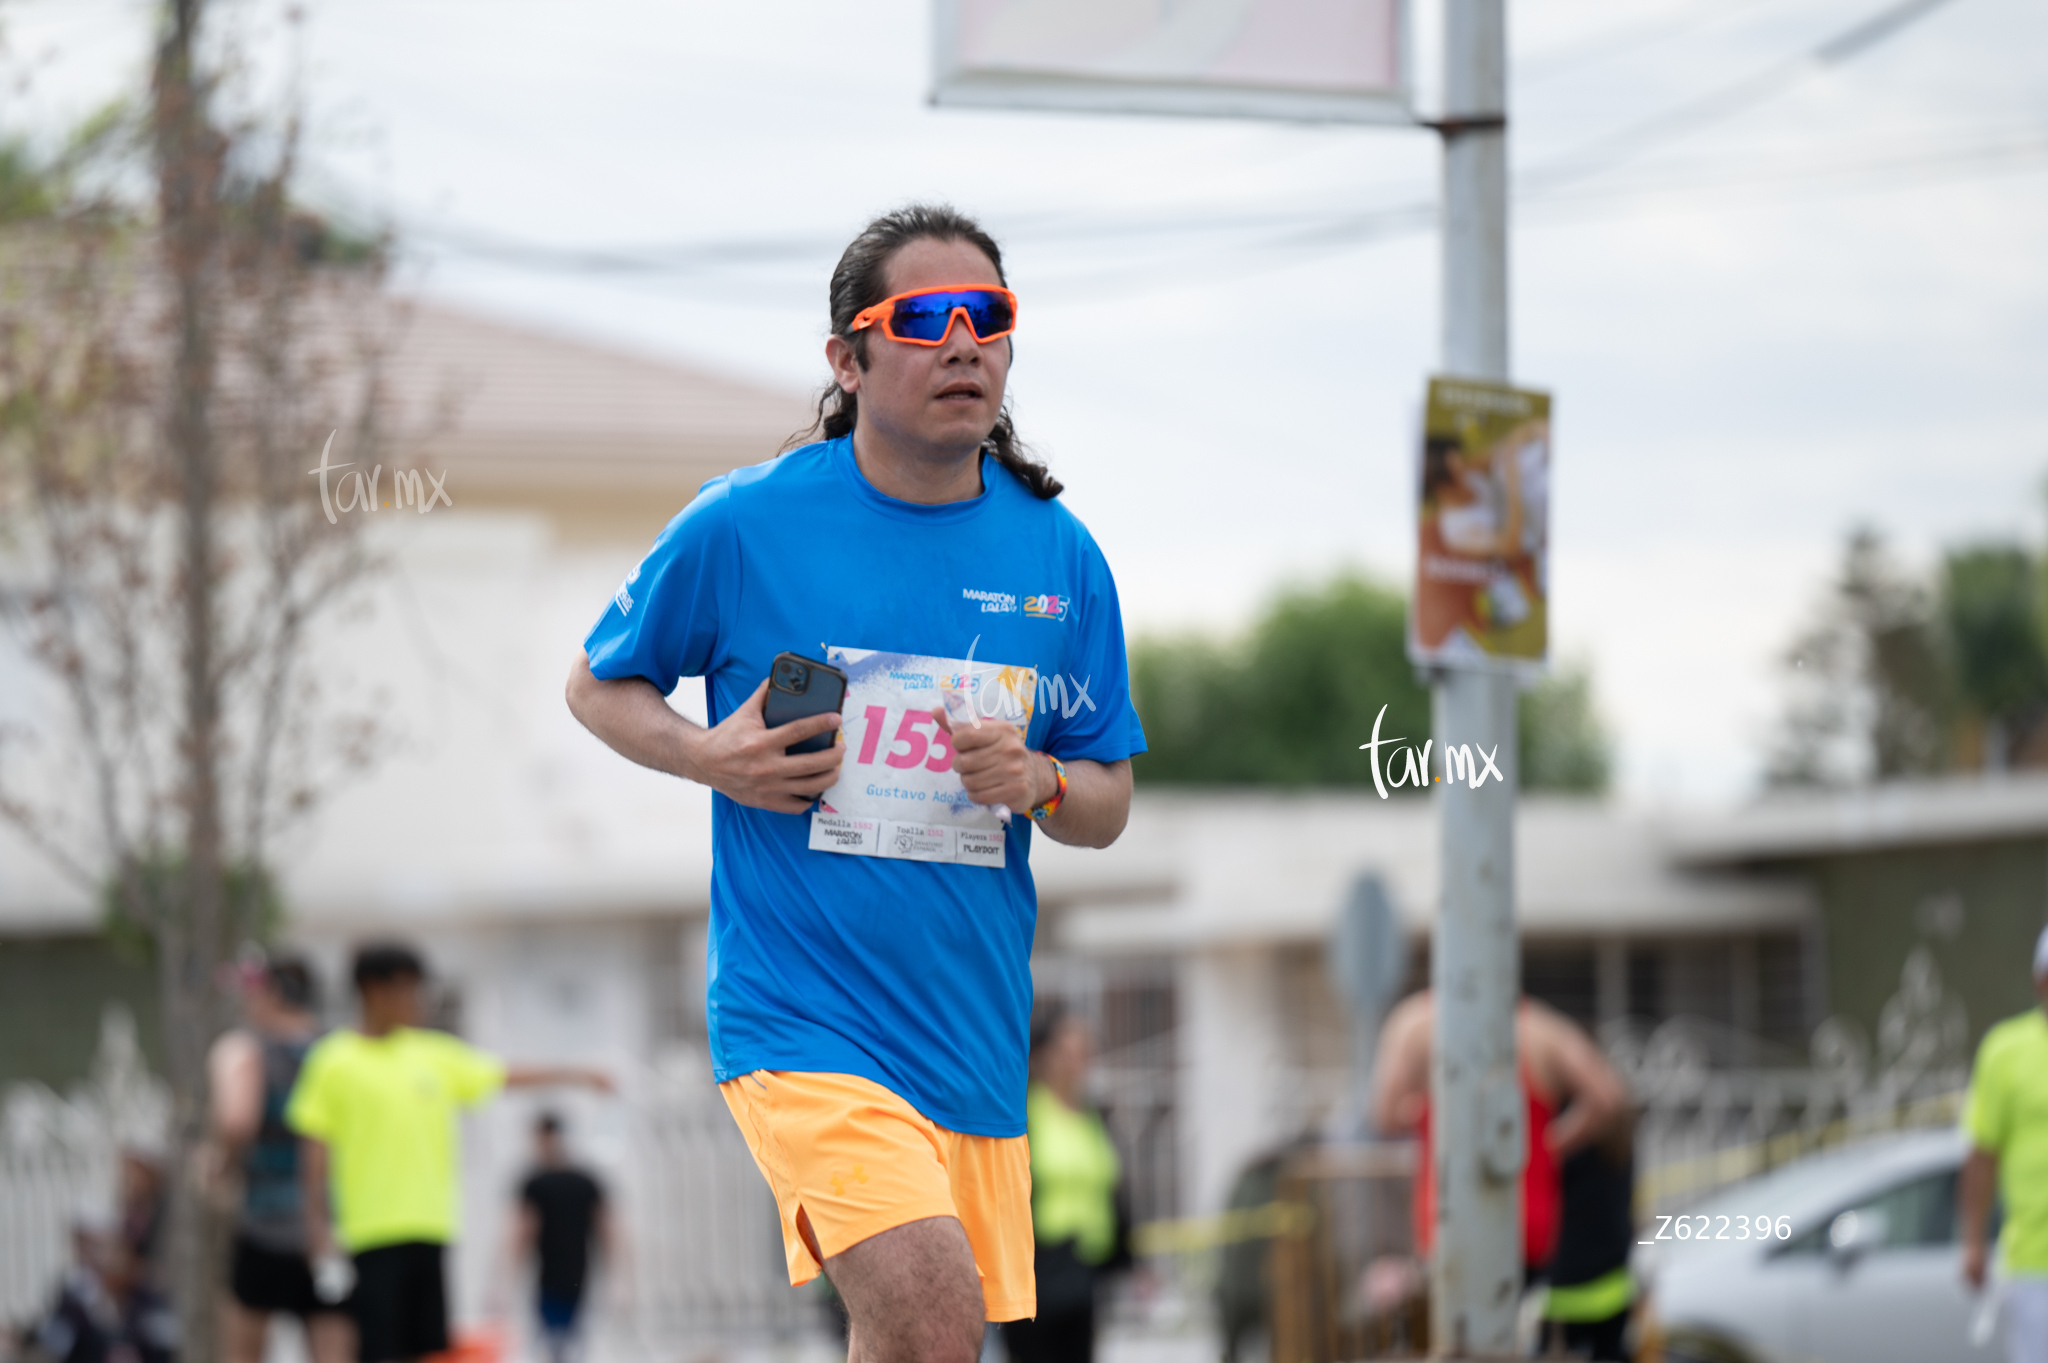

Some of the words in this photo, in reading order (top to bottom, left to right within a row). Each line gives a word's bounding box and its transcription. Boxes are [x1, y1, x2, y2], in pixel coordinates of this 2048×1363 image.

[1024, 594, 1071, 622] 2025
[857, 704, 968, 773] 155
[866, 784, 926, 801] Gustavo
[818, 817, 852, 828] Medalla
[896, 826, 925, 836] Toalla
[961, 831, 988, 841] Playera
